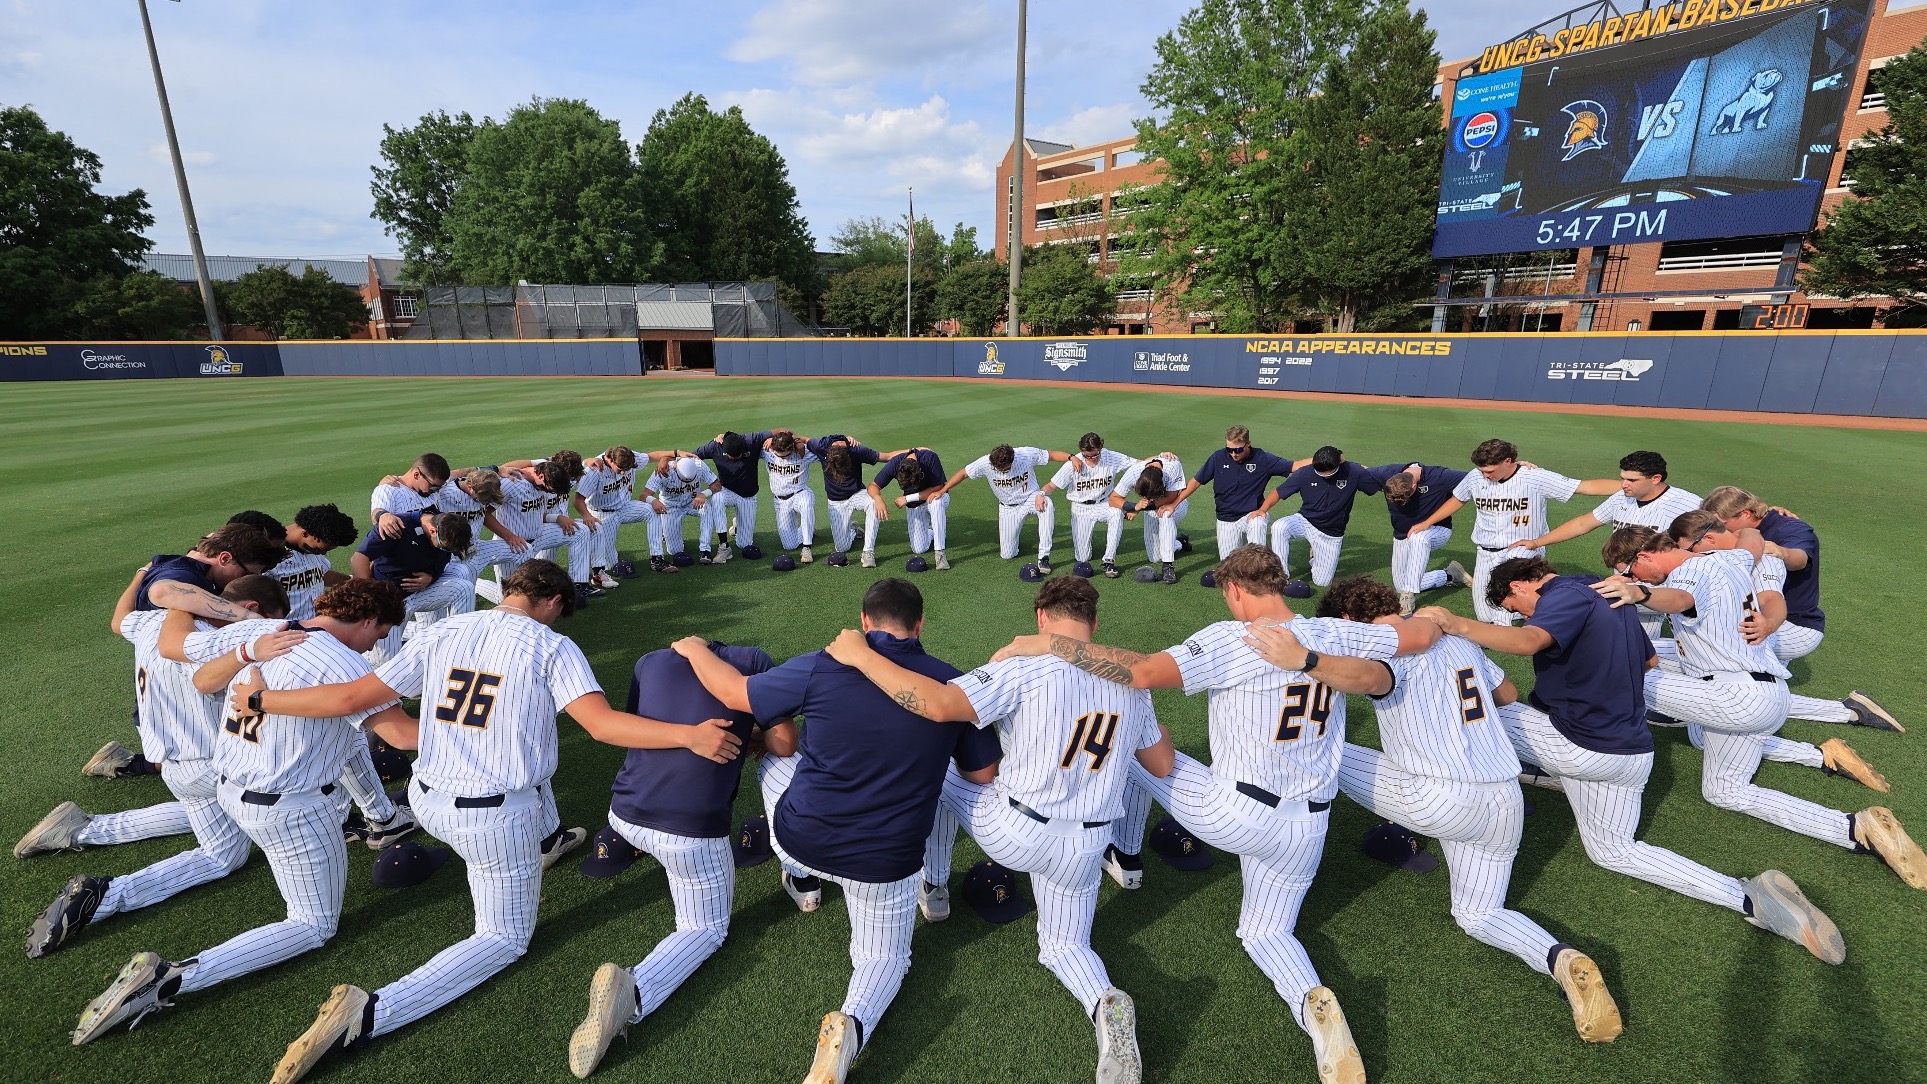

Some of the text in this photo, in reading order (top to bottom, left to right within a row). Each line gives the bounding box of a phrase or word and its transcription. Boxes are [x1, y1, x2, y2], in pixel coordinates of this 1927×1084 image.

[1479, 35, 1546, 73] UNCG
[1550, 3, 1675, 58] SPARTAN
[1637, 100, 1685, 141] VS
[1466, 124, 1496, 136] PEPSI
[1437, 202, 1493, 214] STEEL
[1439, 198, 1473, 206] TRI-STATE
[1536, 208, 1667, 244] 5:47 PM
[1246, 340, 1452, 356] NCAA APPEARANCES
[81, 349, 126, 362] GRAPHIC
[1150, 352, 1189, 362] Triad Foot &
[1260, 357, 1313, 365] 1994 2022
[83, 358, 147, 370] CONNECTION
[201, 363, 242, 373] UNCG
[979, 362, 1004, 373] UNCG
[1150, 362, 1168, 371] Ankle
[1168, 363, 1191, 372] Center
[1549, 361, 1606, 369] TRI-STATE
[1259, 367, 1281, 375] 1997
[1547, 369, 1640, 381] STEEL
[1257, 377, 1279, 385] 2017
[767, 461, 801, 475] SPARTANS
[992, 471, 1029, 488] SPARTANS
[1076, 475, 1113, 492] SPARTANS
[1475, 497, 1529, 512] SPARTANS
[1512, 514, 1530, 528] 44
[435, 665, 504, 731] 36
[1456, 665, 1487, 726] 5
[1273, 680, 1335, 743] 24
[1059, 710, 1121, 773] 14
